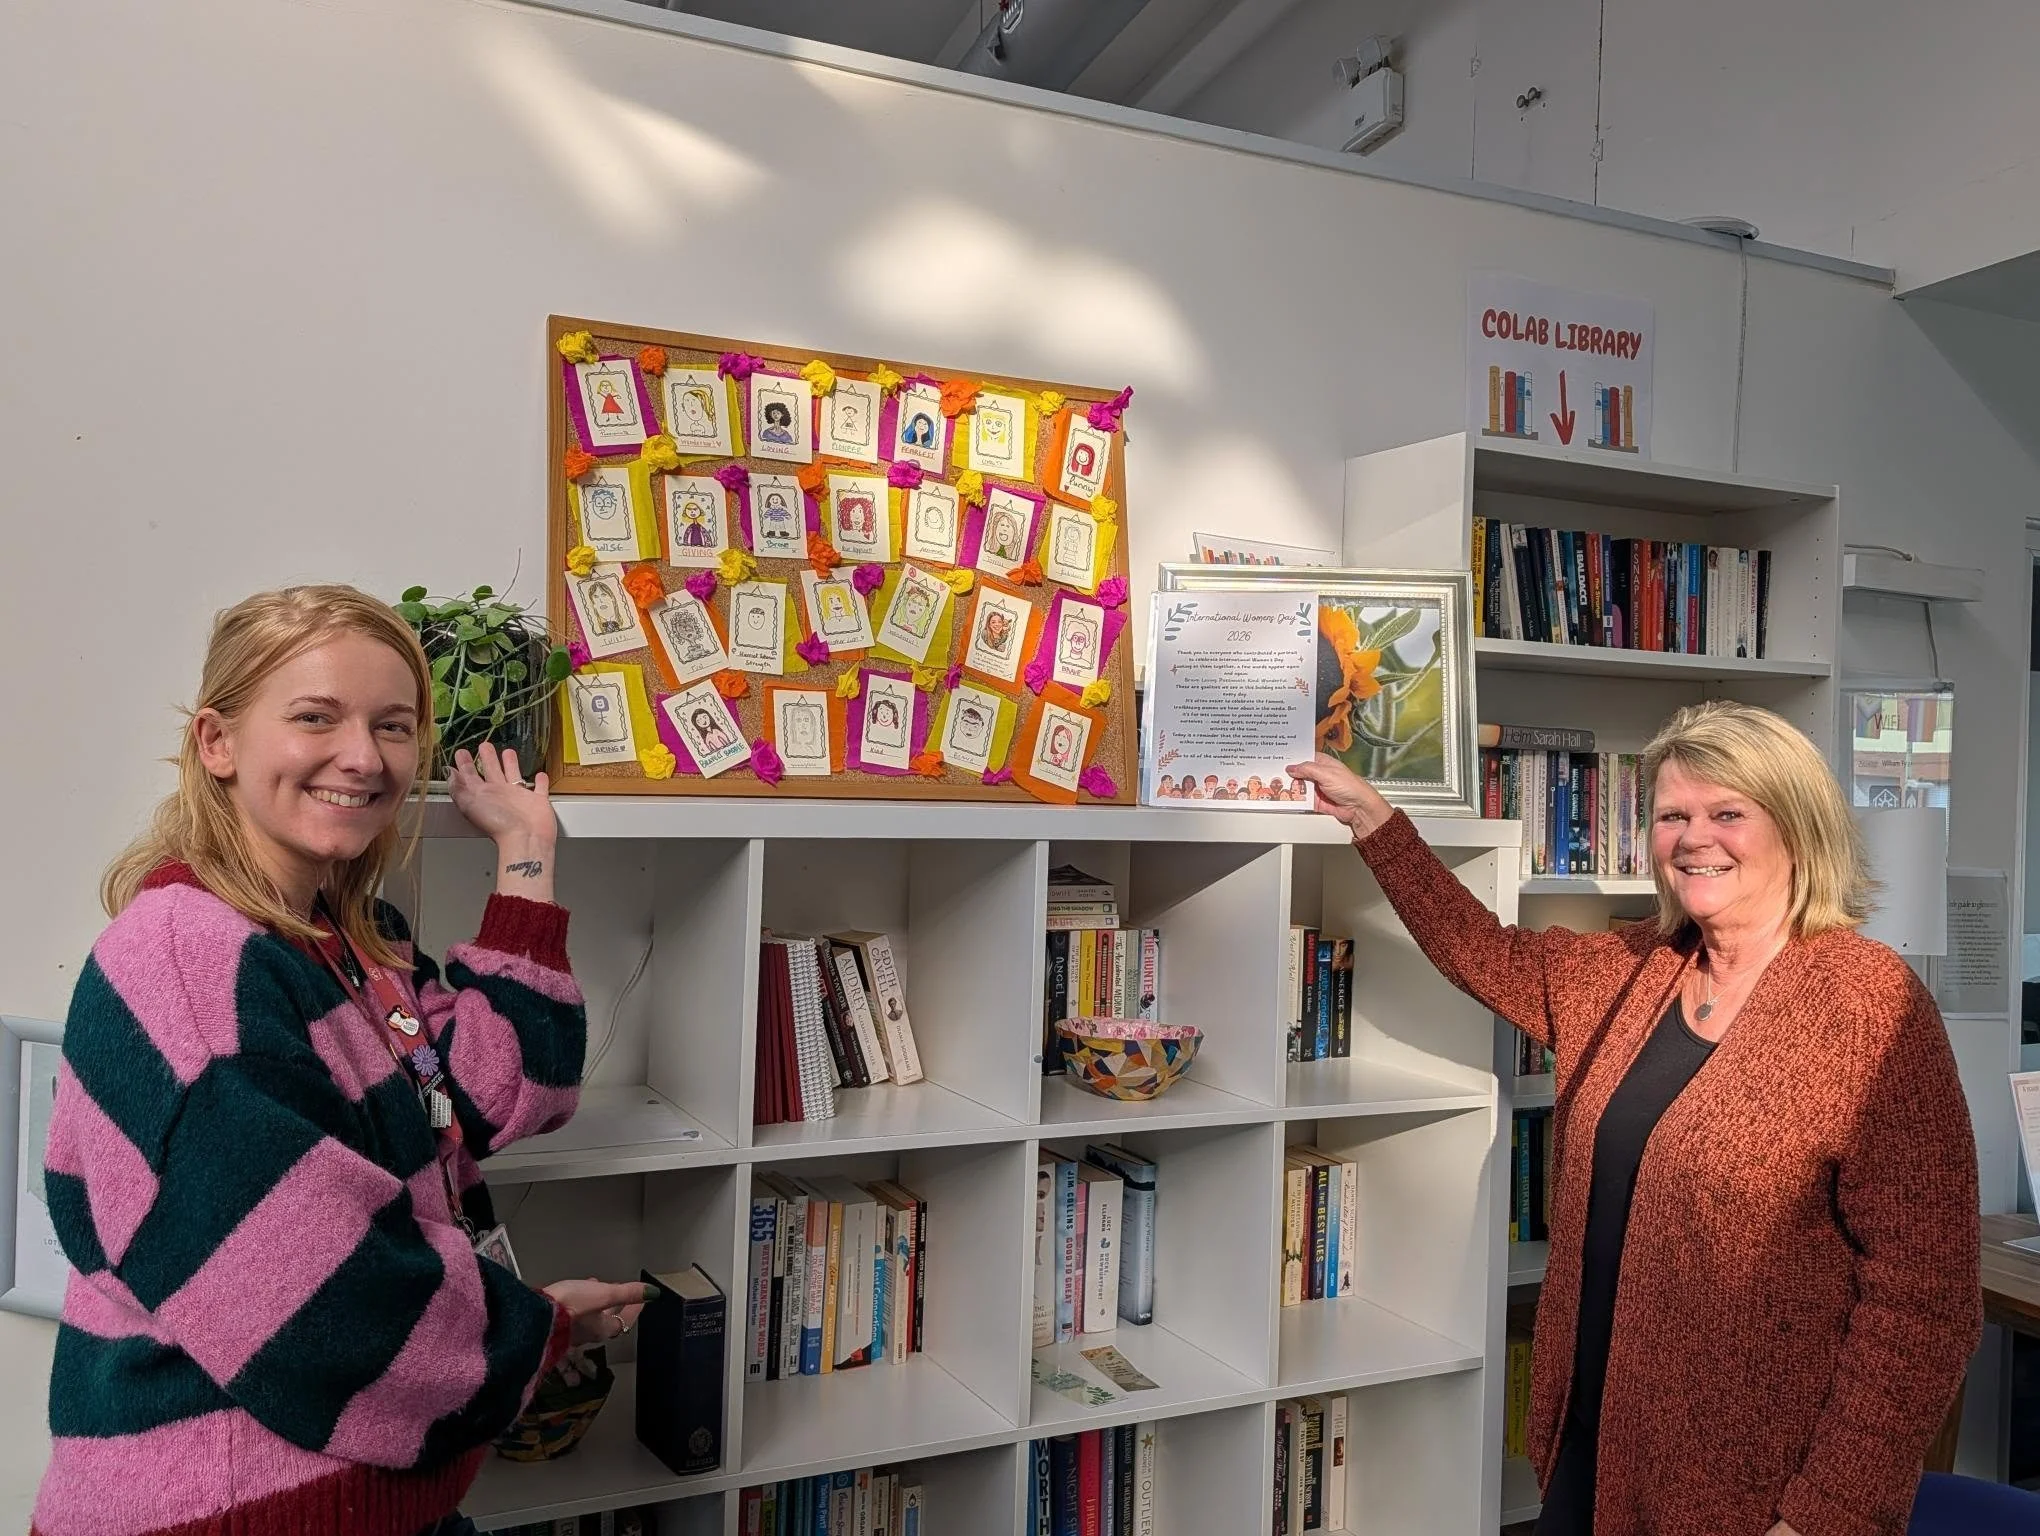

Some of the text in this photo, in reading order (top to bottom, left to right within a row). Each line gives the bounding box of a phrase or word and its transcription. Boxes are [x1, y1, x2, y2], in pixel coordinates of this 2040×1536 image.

[1482, 309, 1641, 360] COLAB LIBRARY
[761, 444, 790, 455] LOVING
[901, 446, 936, 459] FEARLESS
[682, 548, 713, 558] GIVING
[1187, 613, 1240, 622] International
[1278, 614, 1297, 625] Day
[1227, 631, 1251, 641] 2026
[745, 659, 772, 671] Strength
[1874, 711, 1900, 730] WiFi
[1533, 731, 1561, 746] Sarah
[1562, 732, 1581, 748] Hall
[1144, 936, 1154, 955] THE
[871, 948, 888, 997] CAVELL
[880, 949, 896, 987] EDITH
[1054, 957, 1065, 997] ANGEL
[1115, 952, 1123, 987] Accidental
[832, 978, 846, 1010] TAYLOR
[841, 958, 866, 1012] AUDREY
[1114, 990, 1122, 1015] MEDIUM
[1320, 970, 1329, 1031] ruth rendell
[1319, 1171, 1327, 1190] ALL
[752, 1205, 775, 1242] 365
[1066, 1192, 1074, 1230] COLLINS
[1317, 1206, 1326, 1234] BEST
[1316, 1238, 1325, 1263] LIES
[761, 1266, 768, 1277] TO
[1065, 1262, 1072, 1274] TO
[760, 1279, 768, 1310] CHANGE
[1064, 1277, 1072, 1305] GREAT
[759, 1312, 767, 1329] THE
[871, 1287, 880, 1342] Connections
[1034, 1439, 1049, 1535] WORTH
[1142, 1480, 1152, 1536] OUTLIER
